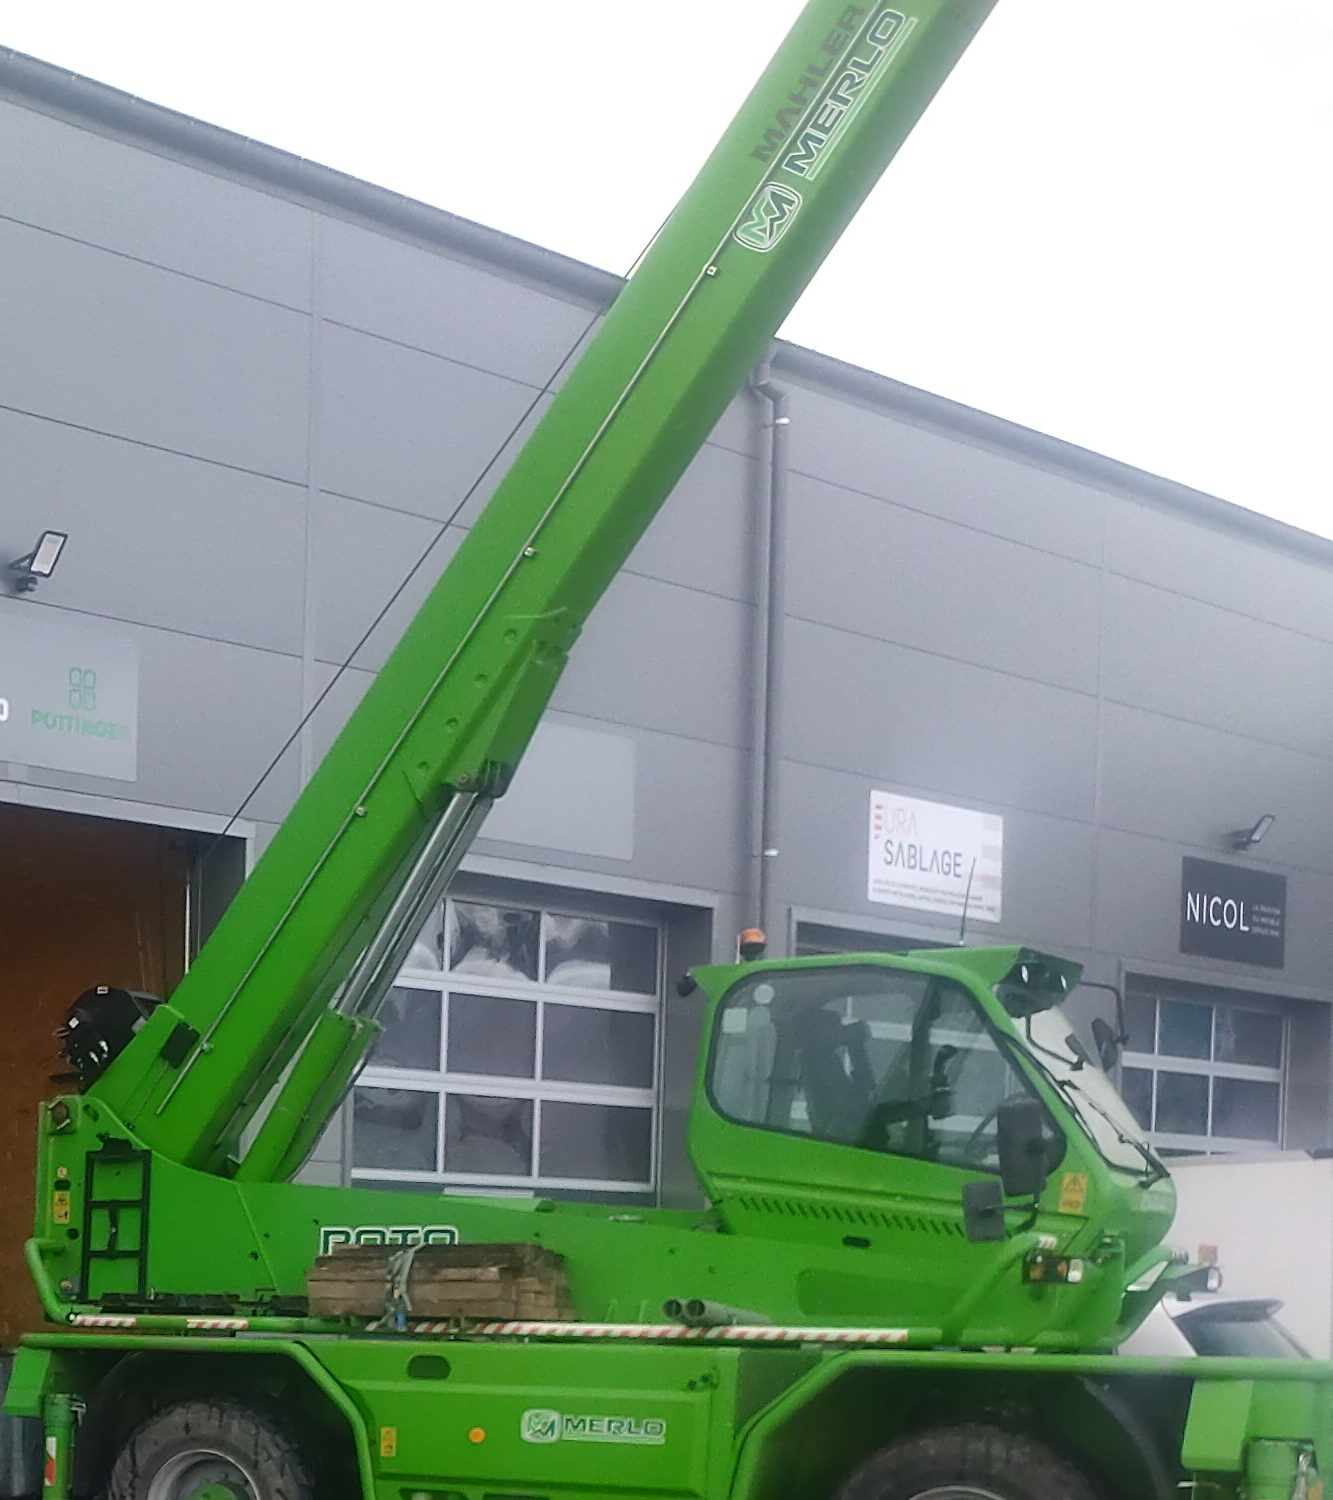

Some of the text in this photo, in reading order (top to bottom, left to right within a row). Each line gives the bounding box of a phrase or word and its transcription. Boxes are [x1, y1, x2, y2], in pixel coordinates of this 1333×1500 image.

[751, 5, 866, 164] MAHLER
[782, 9, 906, 176] MERLO
[884, 839, 963, 879] SABLAGE
[1186, 891, 1250, 931] NICOL
[564, 1416, 664, 1436] MERLO
